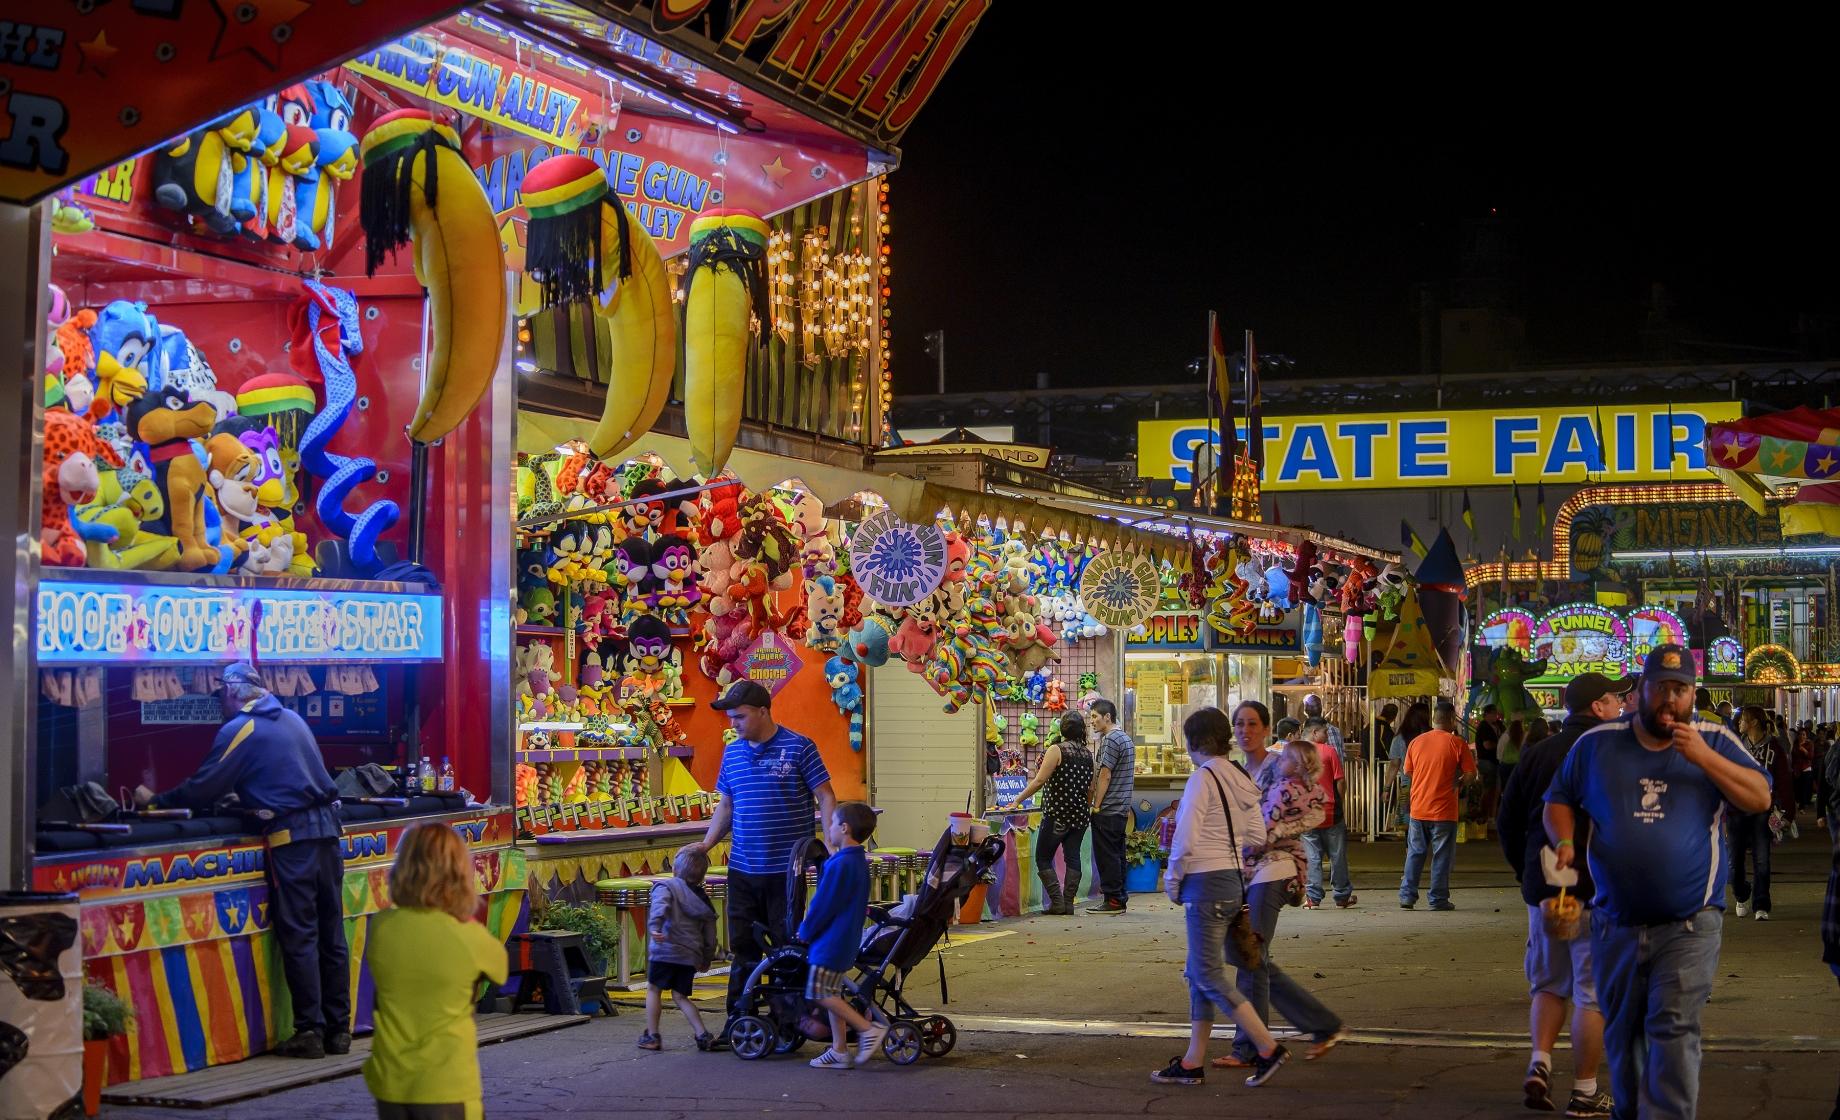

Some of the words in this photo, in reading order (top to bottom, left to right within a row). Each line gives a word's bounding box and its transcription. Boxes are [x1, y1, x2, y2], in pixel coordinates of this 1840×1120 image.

[436, 47, 502, 113] GUN
[500, 75, 580, 138] ALLEY
[643, 160, 710, 214] GUN
[1492, 411, 1708, 477] FAIR
[914, 524, 944, 567] GUN
[868, 572, 920, 603] FUN
[1082, 550, 1135, 587] WATER
[1133, 561, 1158, 600] GUN
[1094, 601, 1137, 626] FUN
[1549, 614, 1614, 634] FUNNEL
[1217, 628, 1297, 646] DRINKS
[1546, 661, 1621, 675] CAKES
[340, 834, 388, 861] UN
[123, 850, 264, 889] MACHI
